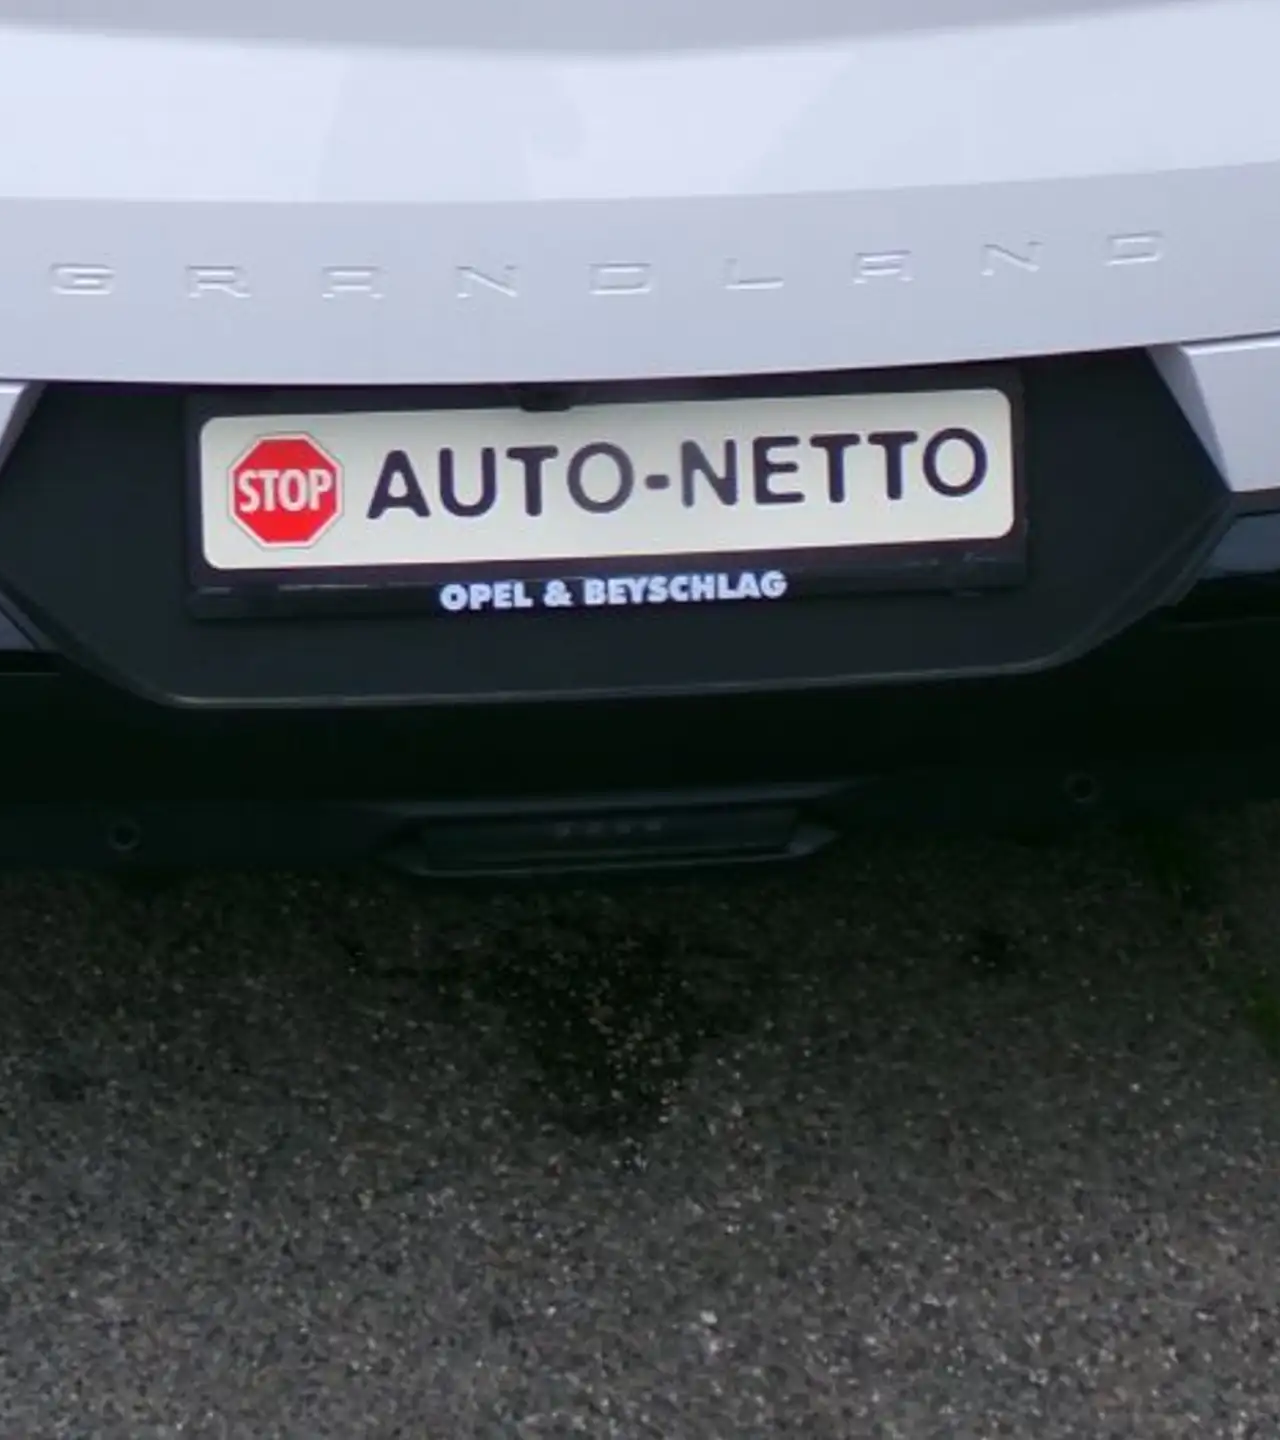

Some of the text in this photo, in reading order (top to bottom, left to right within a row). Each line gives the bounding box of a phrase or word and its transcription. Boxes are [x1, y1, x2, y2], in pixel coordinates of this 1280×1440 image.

[48, 230, 1167, 300] GRANDLAND
[236, 468, 333, 515] STOP
[366, 426, 988, 521] AUTO-NETTO
[439, 570, 788, 612] OPEL & BEYSCHLAG
